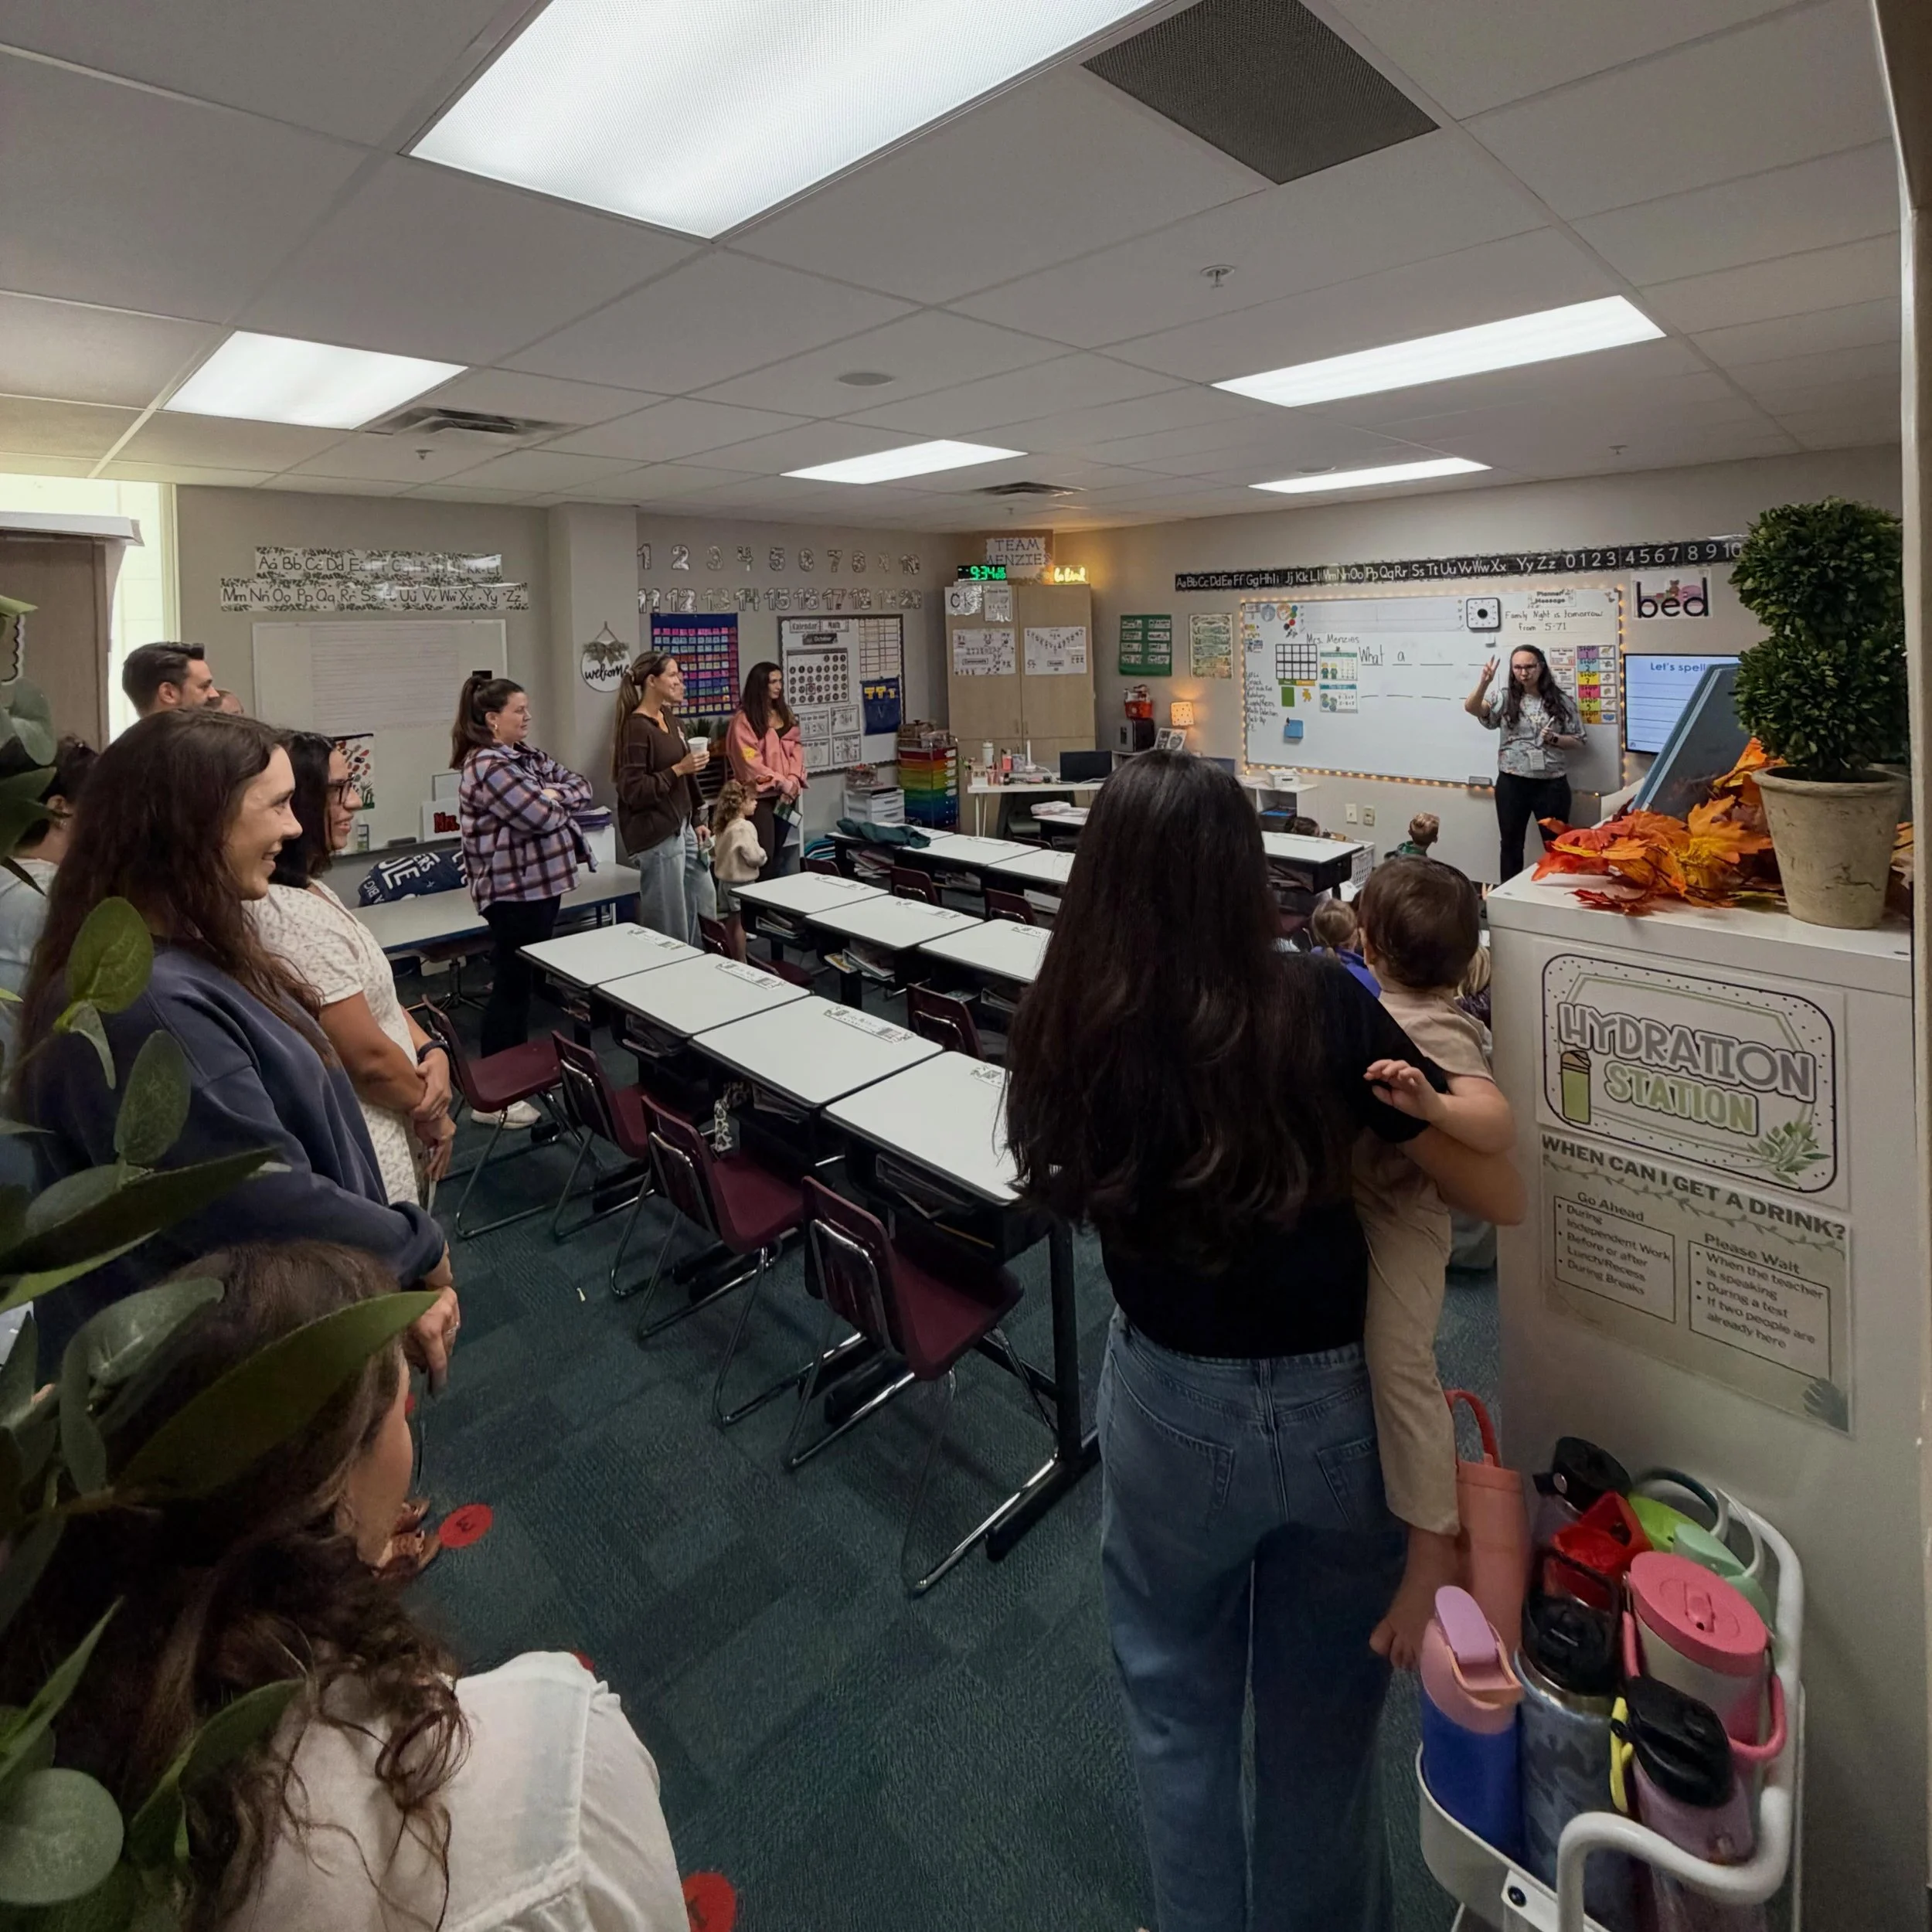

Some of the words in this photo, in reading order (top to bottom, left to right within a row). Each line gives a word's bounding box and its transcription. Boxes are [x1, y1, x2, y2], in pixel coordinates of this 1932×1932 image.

[637, 543, 651, 570] 1
[672, 544, 690, 570] 2
[707, 546, 723, 570] 3
[736, 546, 753, 571] 4
[769, 547, 785, 571] 5
[798, 548, 814, 572] 6
[827, 549, 842, 573] 7
[852, 549, 866, 573] 8
[995, 539, 1040, 551] TEAM
[665, 588, 696, 613] 12
[701, 588, 730, 611] 13
[734, 588, 760, 611] 14
[764, 588, 791, 610] 15
[794, 588, 819, 610] 16
[822, 588, 846, 610] 17
[849, 588, 871, 610] 18
[899, 589, 921, 610] 20
[1505, 610, 1528, 621] Family
[1636, 577, 1709, 618] bed
[1359, 644, 1385, 665] What
[1651, 662, 1675, 672] Let's
[1678, 663, 1706, 673] spell
[1558, 1002, 1815, 1102] HYDRATION
[1604, 1060, 1758, 1136] STATION
[1542, 1134, 1604, 1166] WHEN
[1609, 1155, 1656, 1183] CAN
[1661, 1175, 1668, 1186] I
[1672, 1175, 1720, 1201] GET
[1726, 1192, 1743, 1210] A
[1749, 1198, 1845, 1240] DRINK?
[1566, 1204, 1604, 1226] During
[1577, 1192, 1596, 1206] Go
[1600, 1199, 1644, 1223] Ahead
[1566, 1219, 1636, 1250] Independent
[1639, 1242, 1671, 1263] Work
[1566, 1232, 1604, 1252] Before
[1606, 1247, 1617, 1257] or
[1620, 1253, 1648, 1267] after
[1704, 1233, 1757, 1260] Please
[1761, 1251, 1801, 1274] Wait
[1567, 1245, 1646, 1282] Lunch/Recess
[1567, 1259, 1604, 1281] During
[1605, 1274, 1645, 1295] Breaks
[1706, 1251, 1744, 1273] When
[1747, 1266, 1769, 1281] the
[1772, 1274, 1824, 1300] teacher
[1706, 1281, 1749, 1305] During
[1751, 1300, 1760, 1308] a
[1762, 1301, 1788, 1318] test
[1719, 1271, 1777, 1301] speaking
[1706, 1313, 1753, 1337] already
[1756, 1329, 1786, 1349] here
[1719, 1301, 1743, 1316] two
[1746, 1312, 1791, 1335] people
[1793, 1330, 1815, 1344] are
